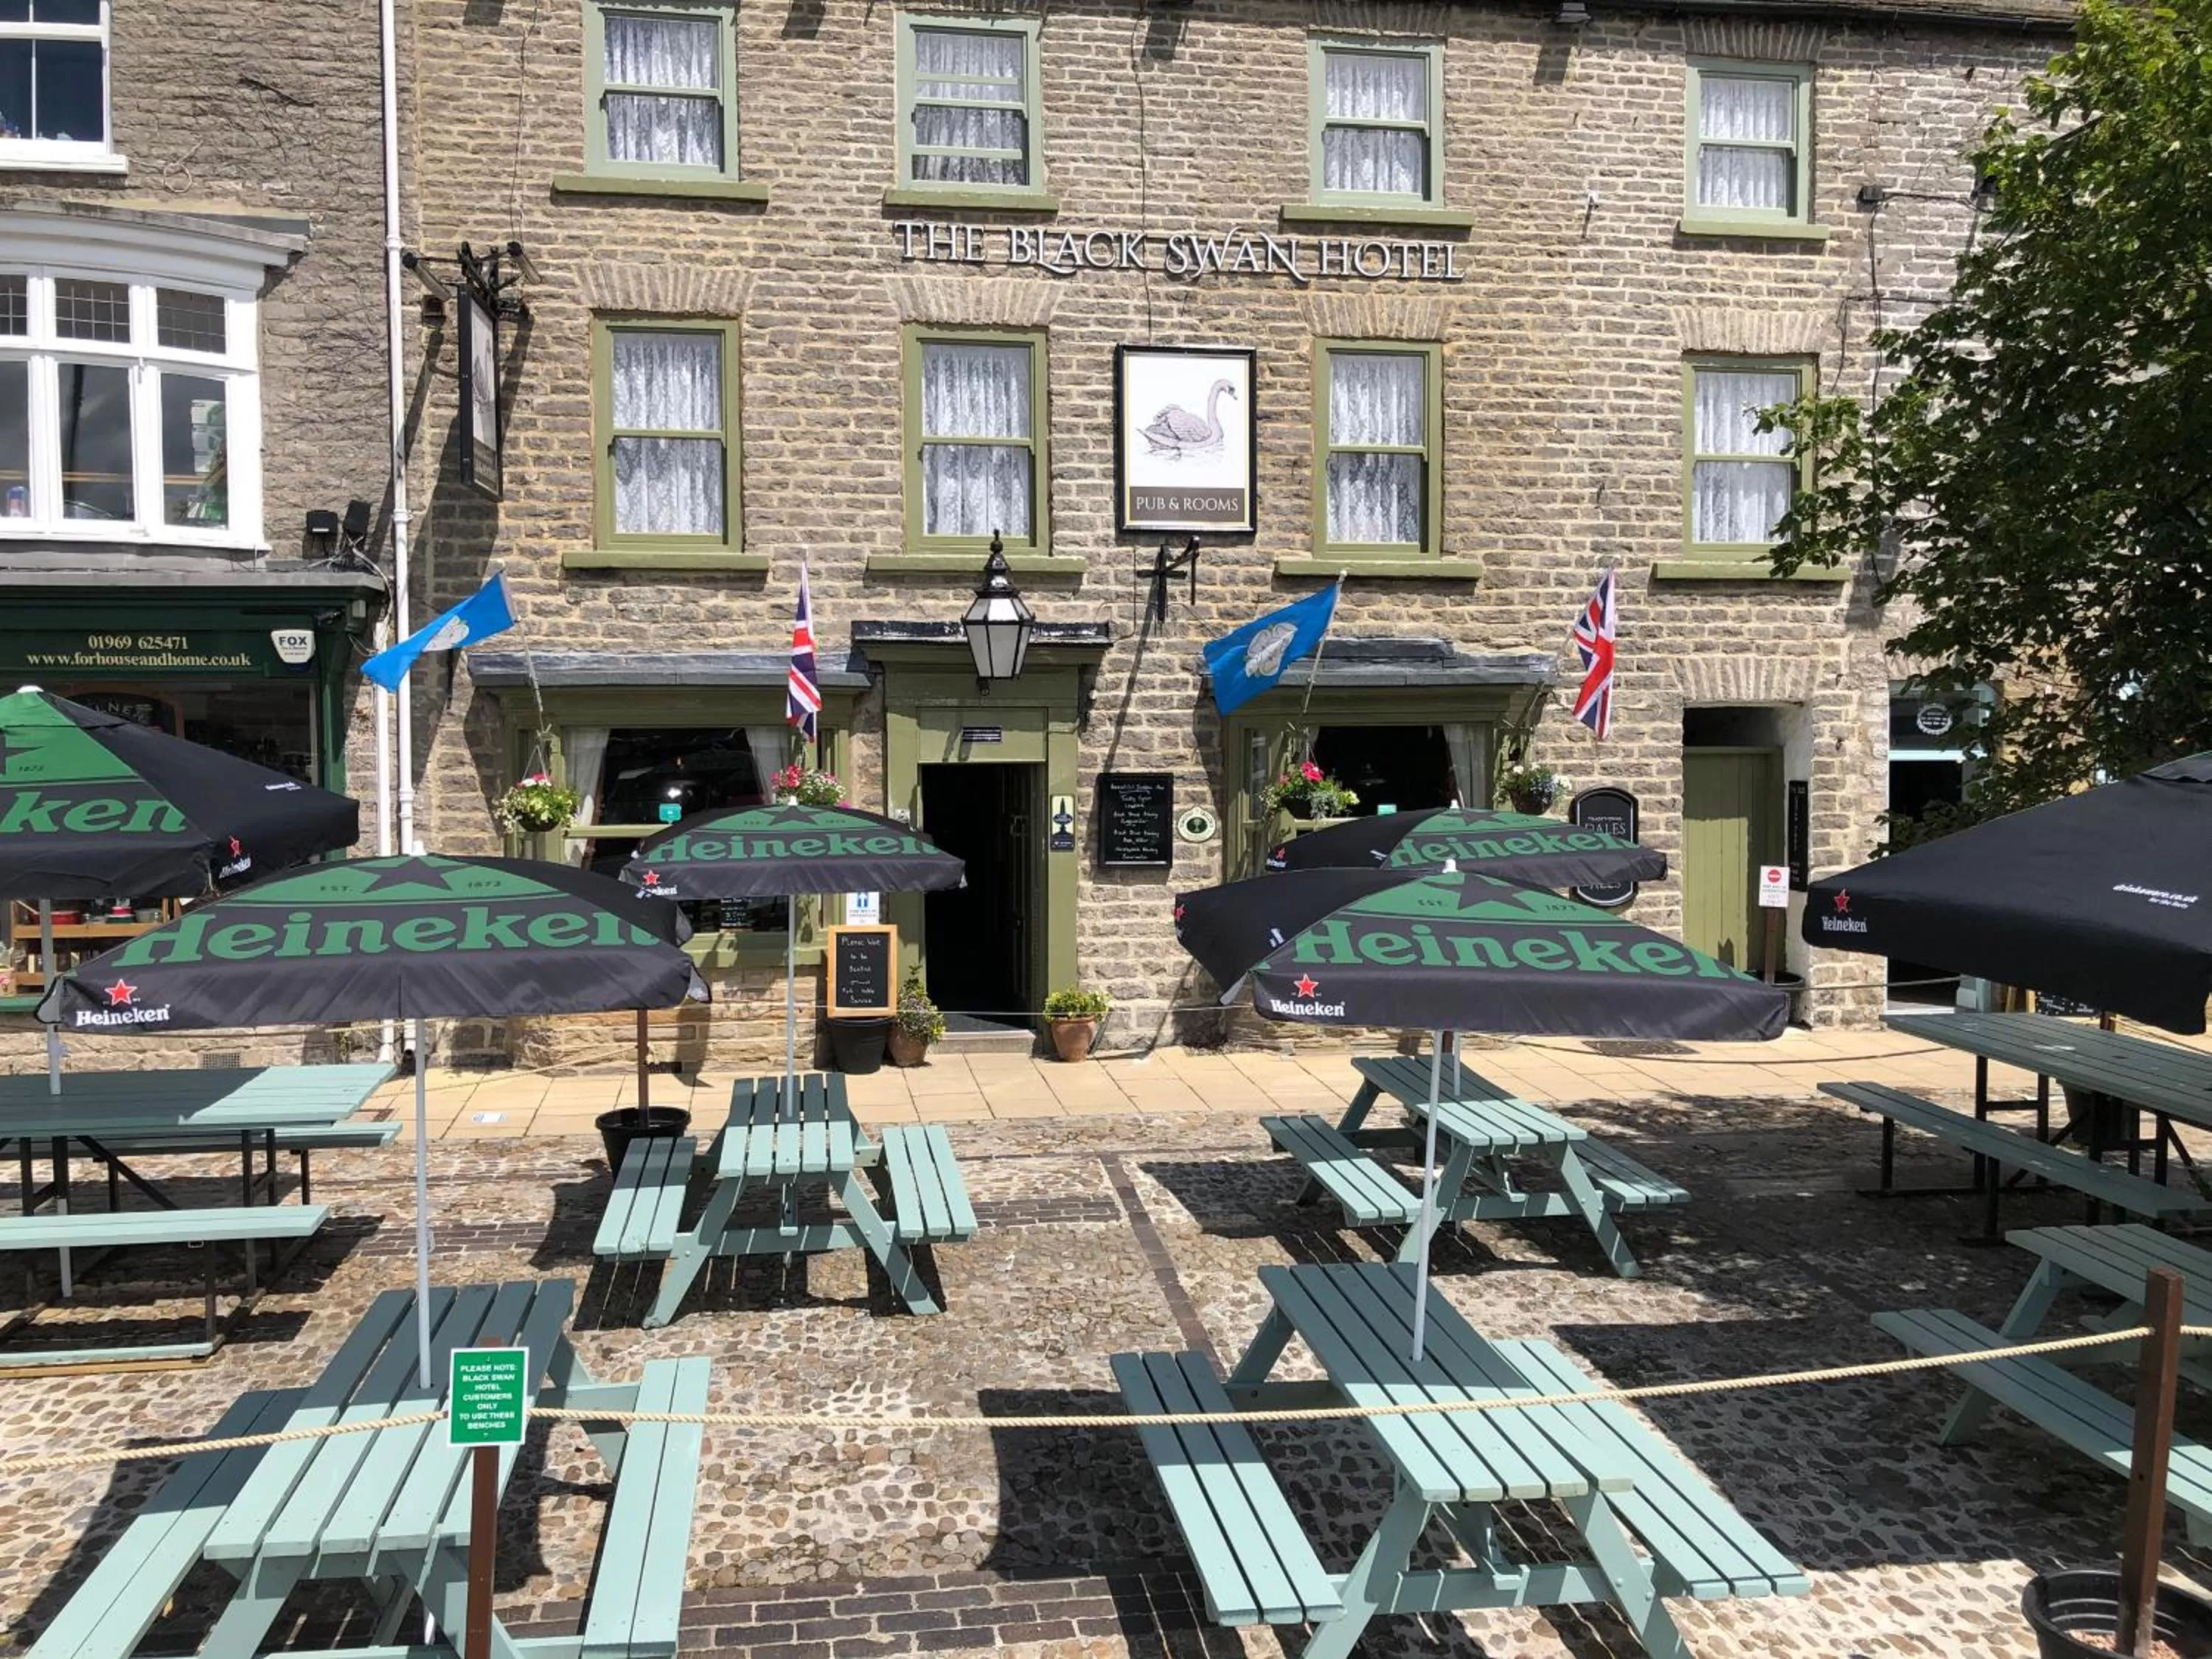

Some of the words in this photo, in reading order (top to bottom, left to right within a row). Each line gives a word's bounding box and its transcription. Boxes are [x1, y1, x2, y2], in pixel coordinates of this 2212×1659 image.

[894, 223, 986, 262] THE
[1007, 228, 1146, 275] BLACK
[1165, 226, 1309, 285] SWAN
[1318, 240, 1466, 280] HOTEL
[1136, 496, 1166, 511] PUB
[1169, 497, 1180, 511] &
[1183, 498, 1239, 512] ROOMS
[88, 635, 132, 650] 01969
[138, 635, 189, 650] 625471
[279, 636, 307, 646] FOX
[27, 652, 251, 667] www.forhouseandhome.co.uk
[643, 833, 939, 863] Heineken
[1391, 832, 1641, 868] Heineken
[1821, 916, 1868, 933] Heineken
[111, 907, 660, 967] Heineken
[1292, 919, 1762, 982] Heineken
[76, 1004, 170, 1026] Heineken
[1270, 999, 1346, 1017] Heineken
[460, 1364, 492, 1372] PLEASE
[462, 1374, 490, 1382] BLACK
[491, 1373, 515, 1381] SWAN
[474, 1382, 501, 1391] HOTEL
[462, 1392, 512, 1402] CUSTOMERS
[476, 1402, 498, 1411] ONLY
[459, 1413, 470, 1421] TO
[489, 1411, 515, 1419] THESE
[467, 1421, 507, 1430] BENCHES
